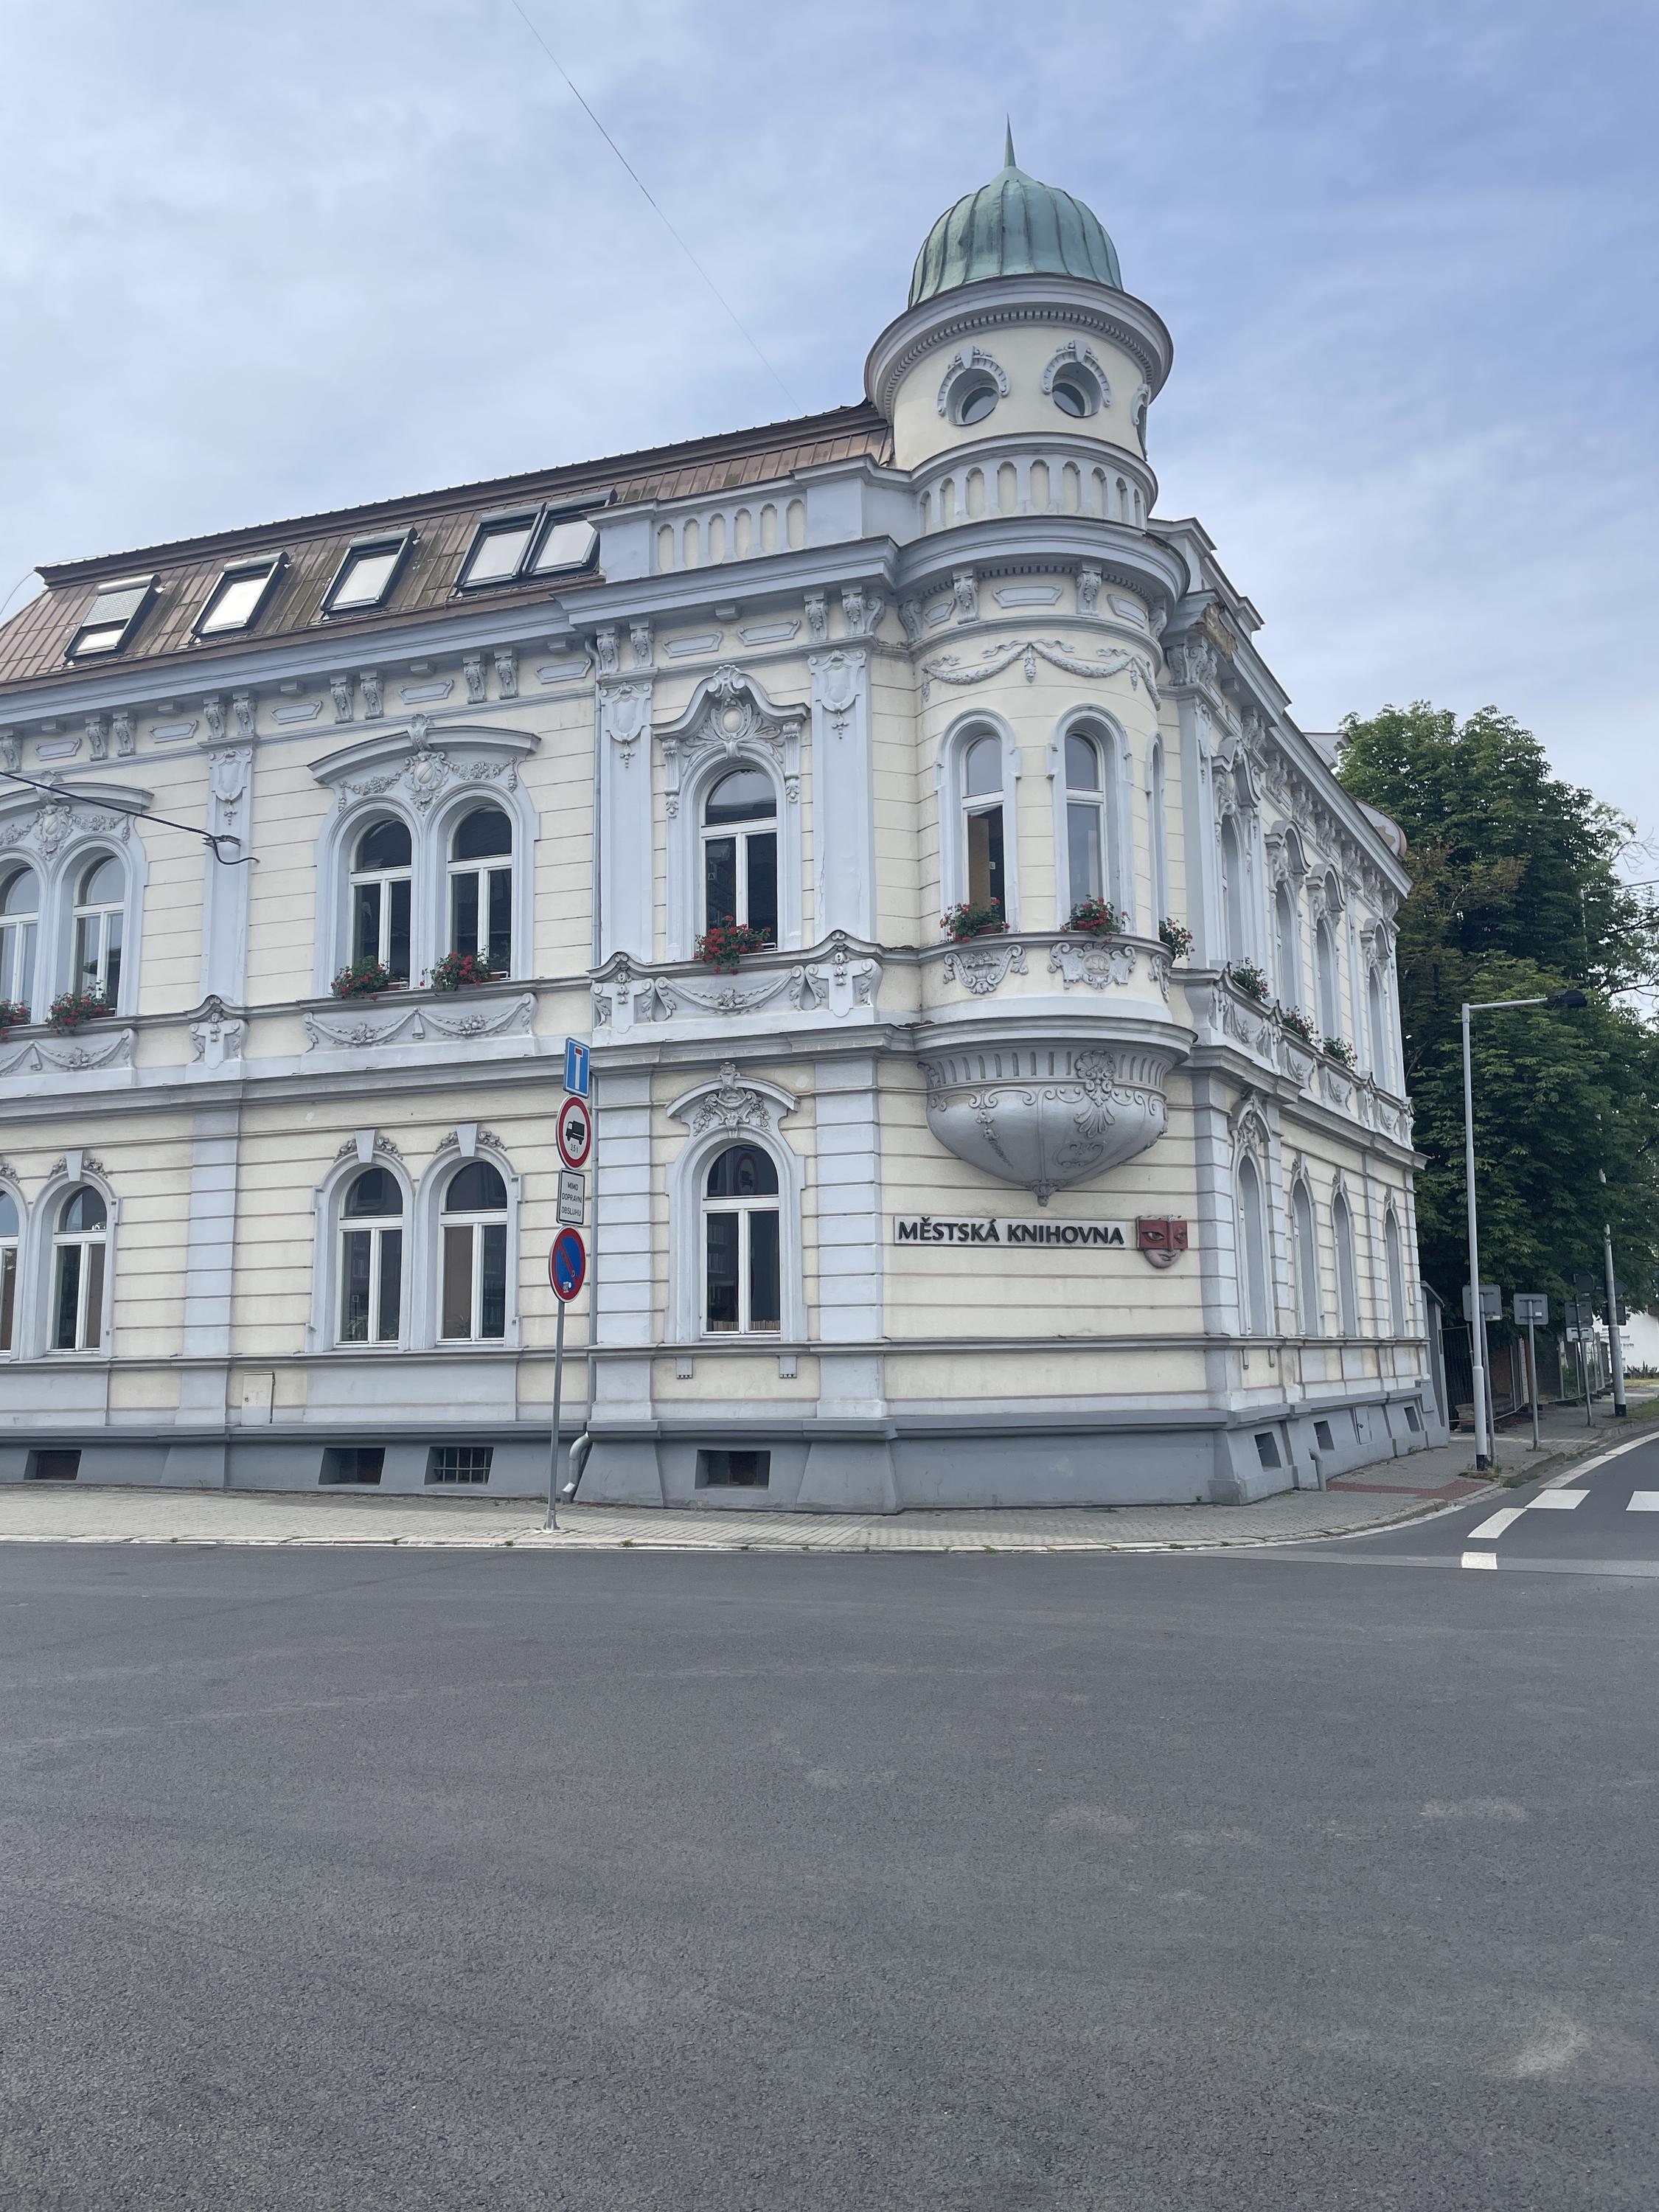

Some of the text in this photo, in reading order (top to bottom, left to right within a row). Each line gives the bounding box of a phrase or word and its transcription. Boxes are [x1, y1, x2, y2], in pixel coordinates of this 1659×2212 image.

[568, 1182, 579, 1191] MIMO
[561, 1206, 582, 1217] OBSLUHU
[898, 1217, 1124, 1245] MĚSTSKÁ KNIHOVNA
